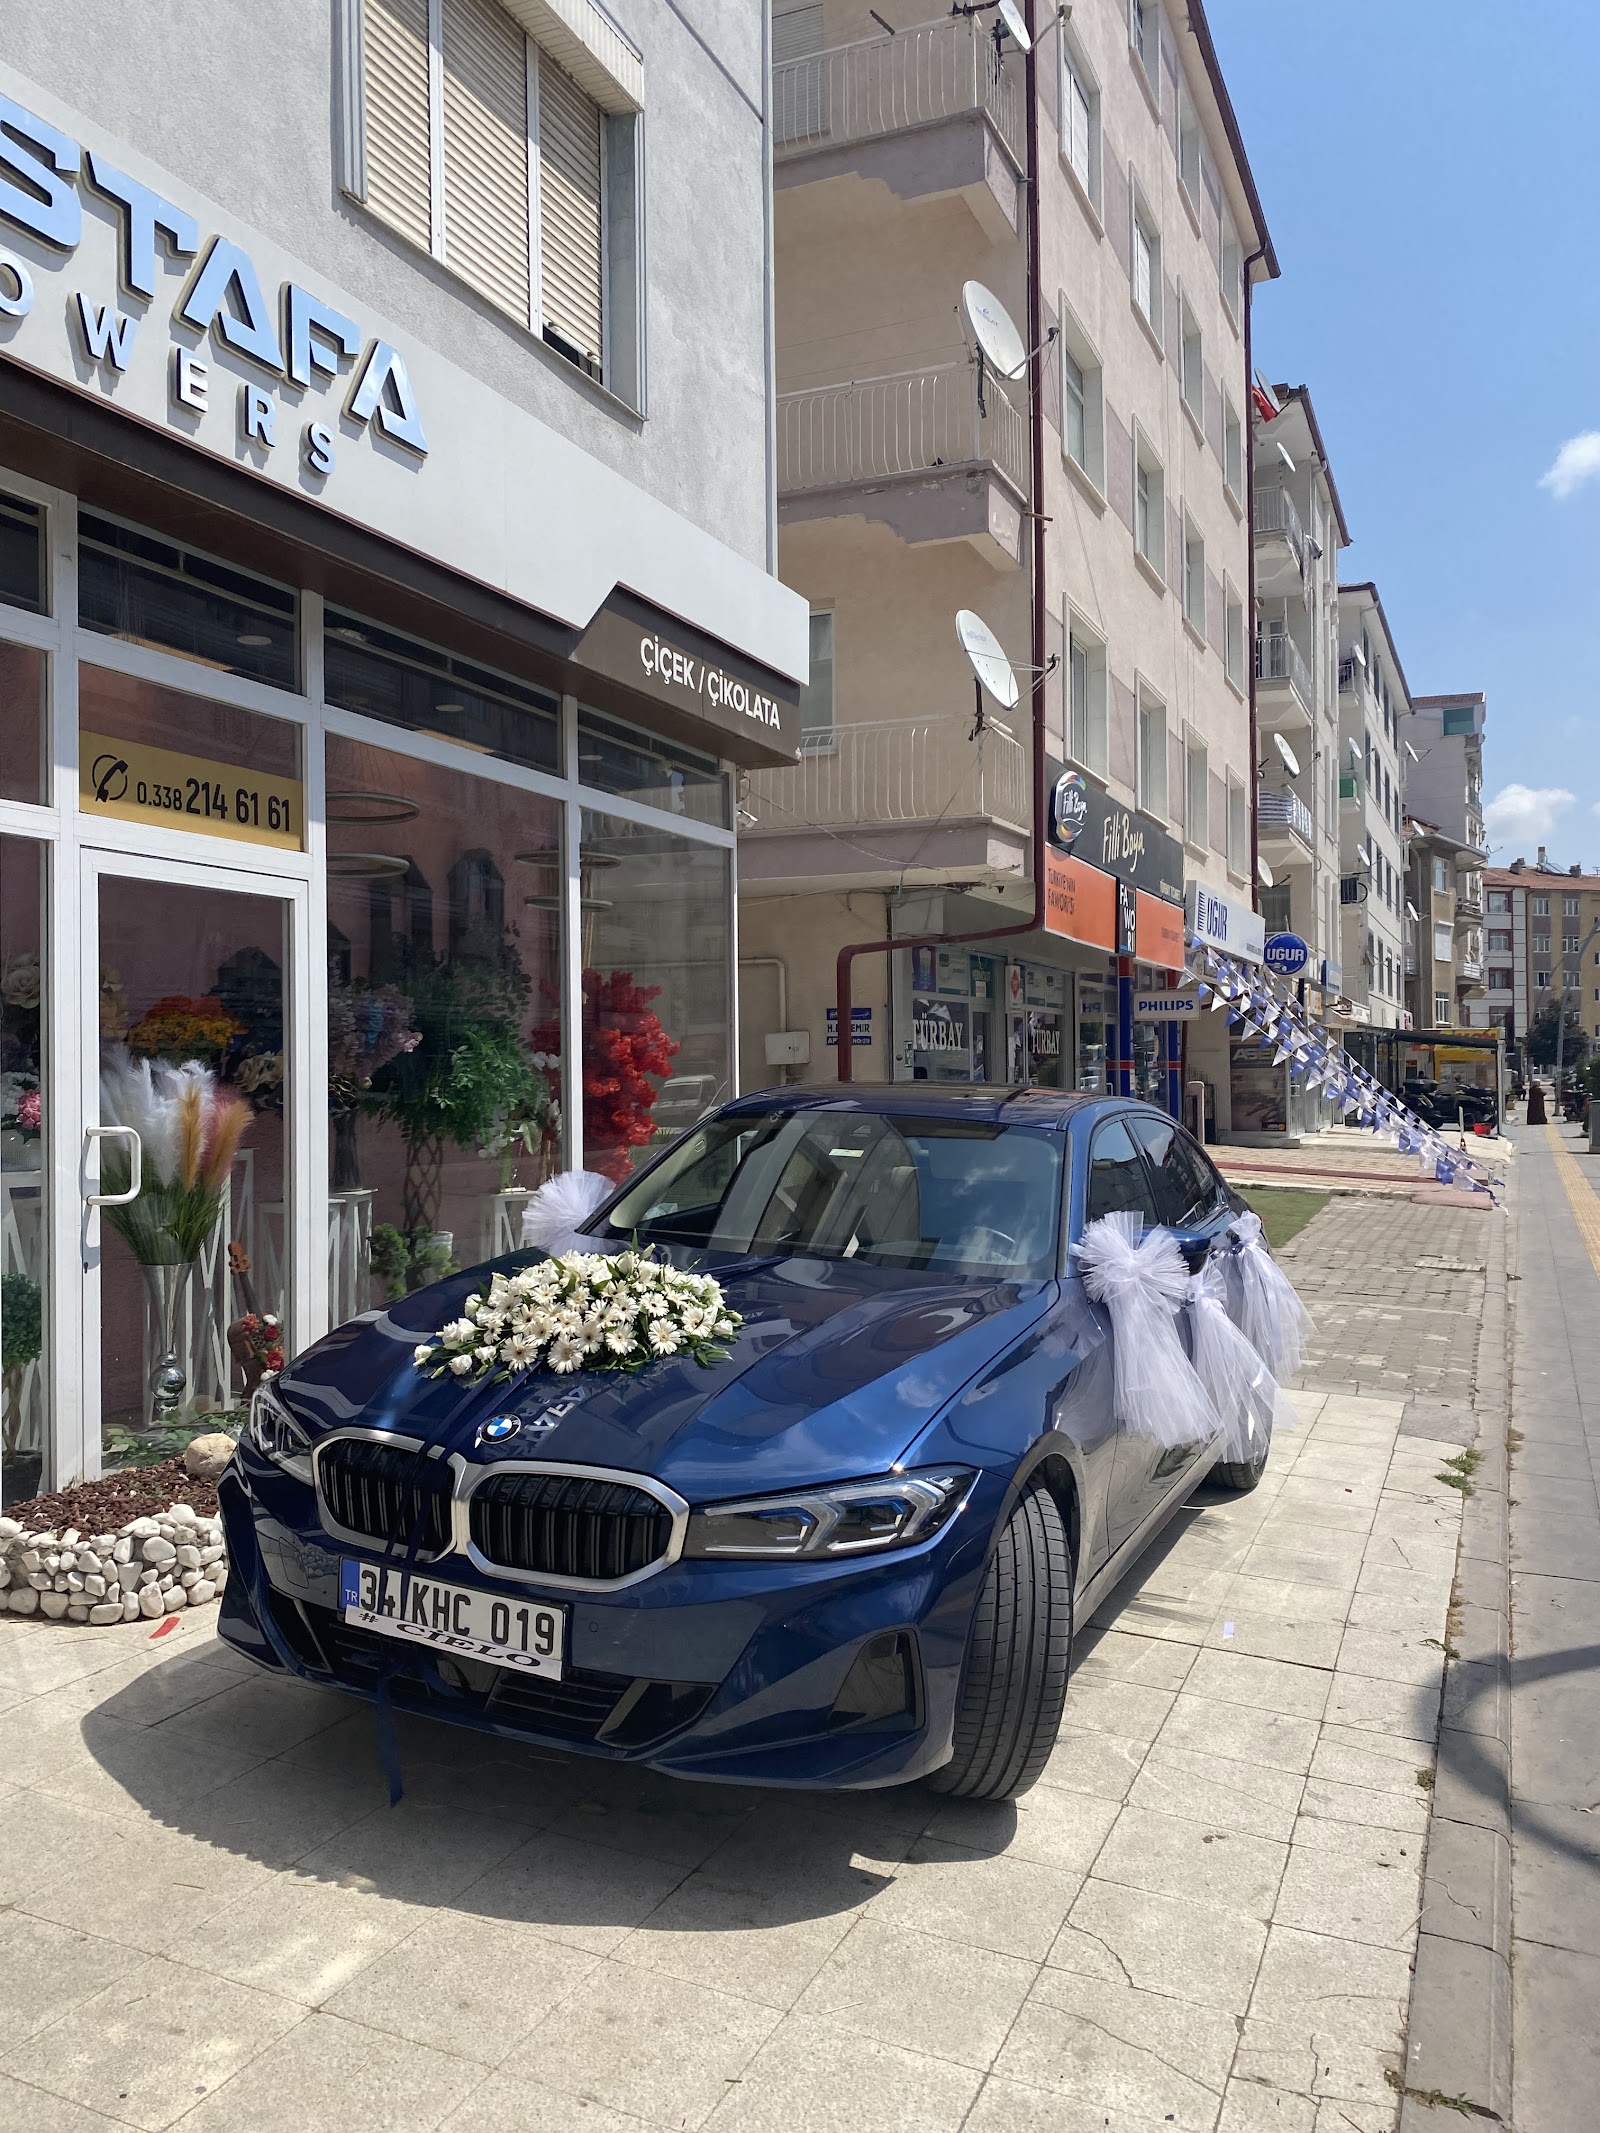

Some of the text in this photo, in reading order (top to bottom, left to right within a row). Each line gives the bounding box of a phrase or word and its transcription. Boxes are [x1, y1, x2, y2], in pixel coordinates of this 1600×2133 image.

[640, 636, 695, 690] ÇİÇEK
[707, 669, 781, 730] ÇİKOLATA
[186, 778, 228, 819] 214
[235, 788, 259, 825] 61
[268, 796, 290, 831] 61
[1102, 811, 1121, 864] Filli
[1266, 947, 1305, 961] UĞUR
[1139, 1000, 1194, 1011] PHILIPS
[345, 1589, 358, 1603] TR
[412, 1582, 471, 1637] KHC
[491, 1602, 555, 1655] 019
